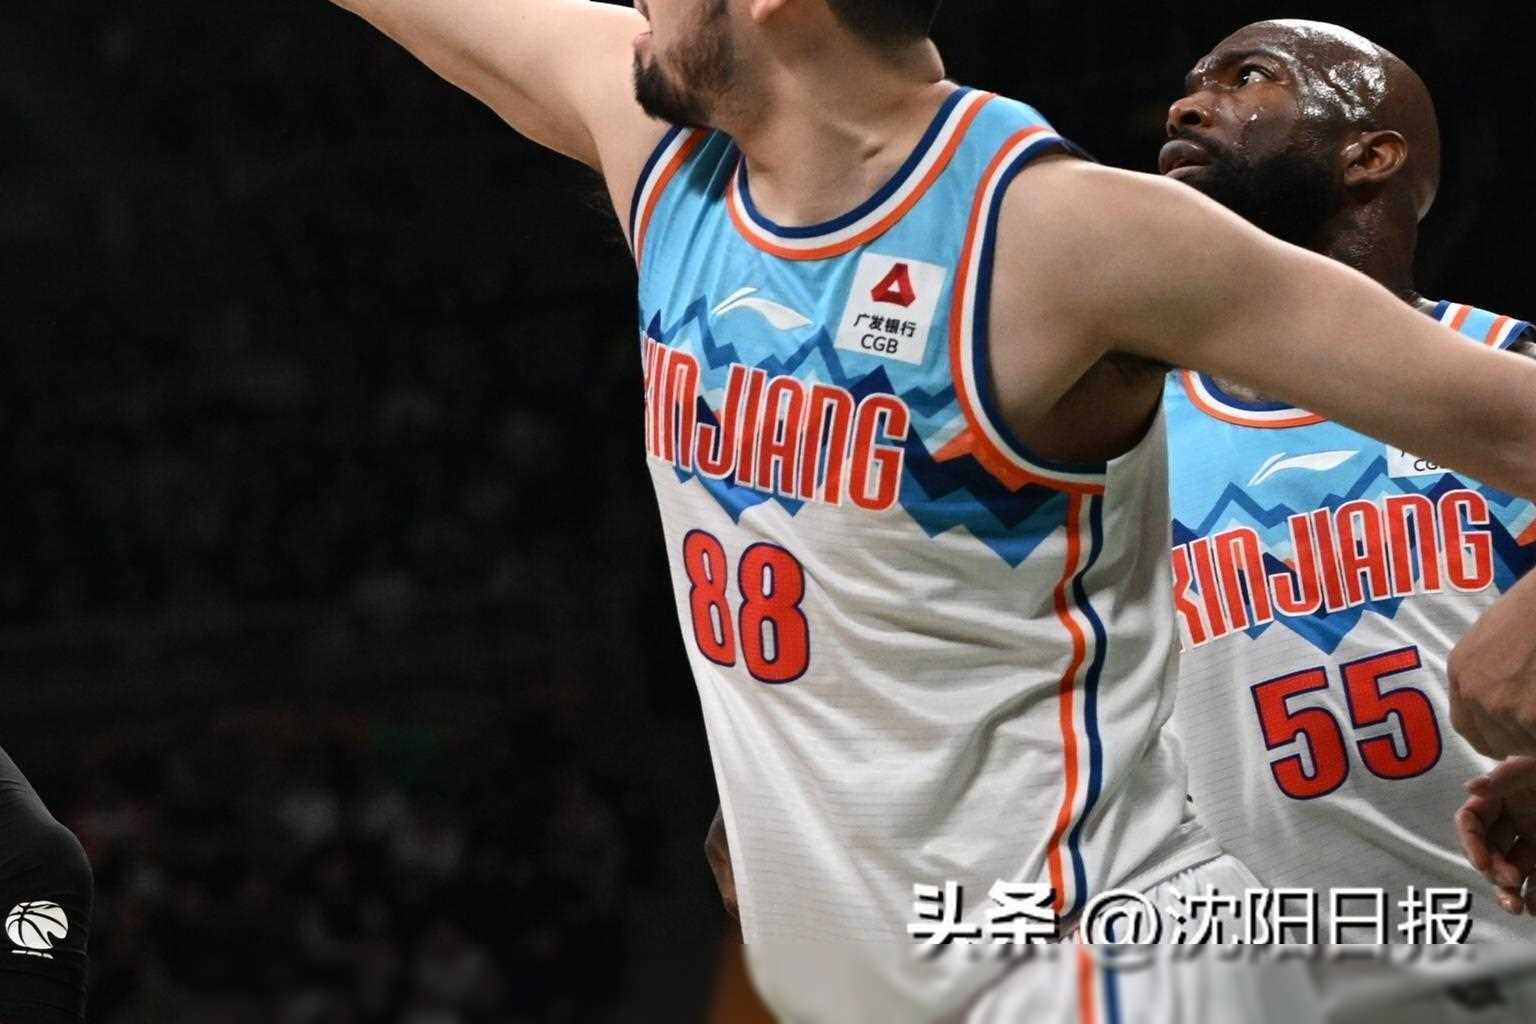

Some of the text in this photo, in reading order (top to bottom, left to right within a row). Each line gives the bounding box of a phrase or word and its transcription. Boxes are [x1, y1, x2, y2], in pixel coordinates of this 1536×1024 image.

[853, 313, 917, 337] 广发银行
[861, 333, 899, 354] CGB
[683, 529, 810, 684] 88
[1250, 645, 1443, 800] 55
